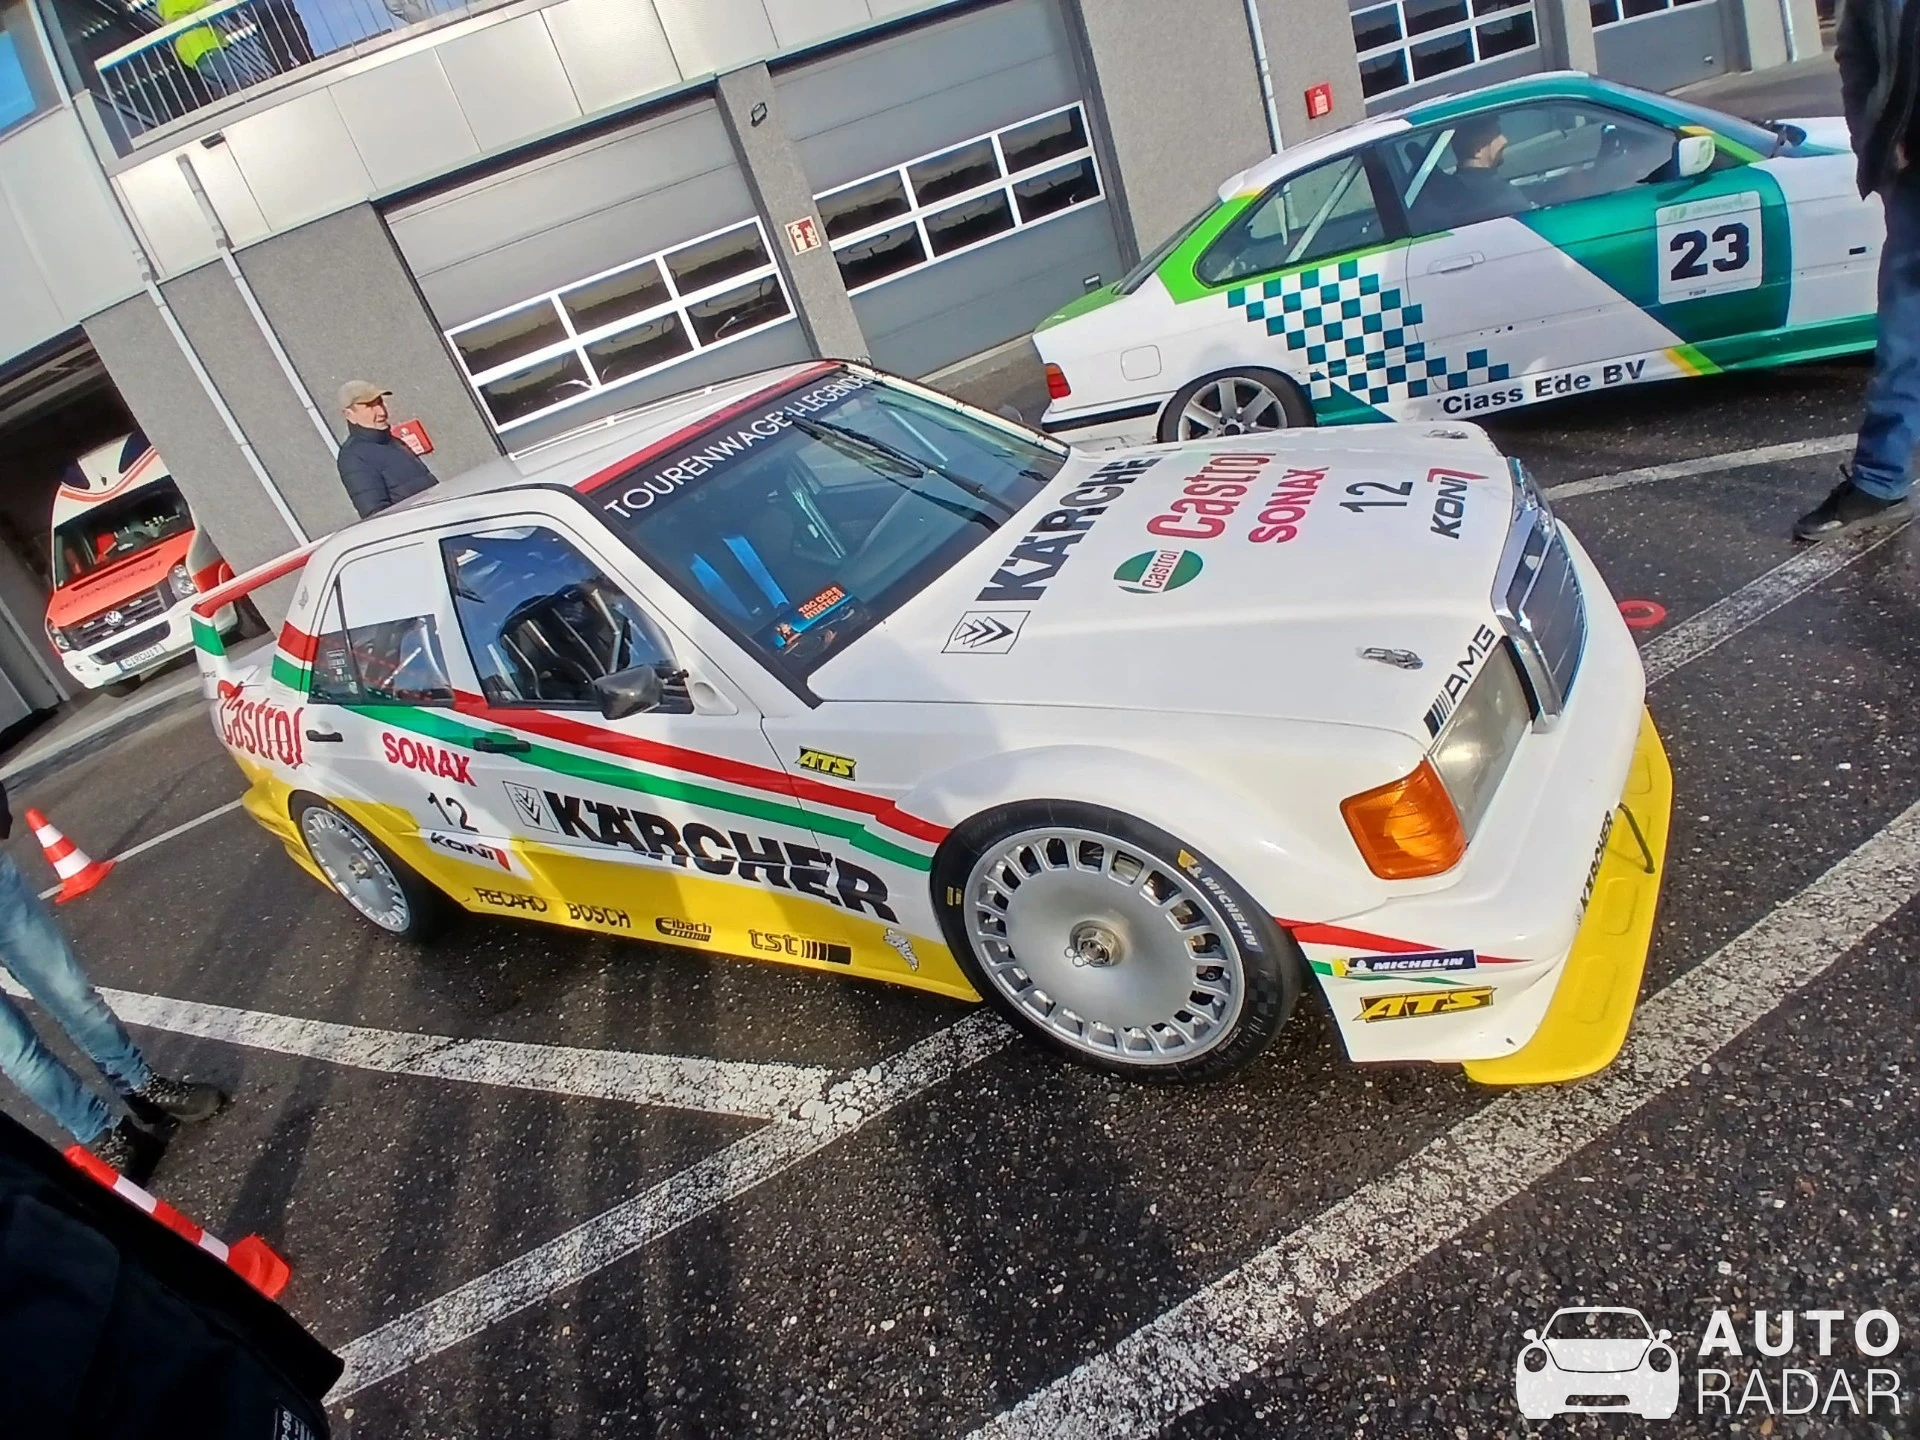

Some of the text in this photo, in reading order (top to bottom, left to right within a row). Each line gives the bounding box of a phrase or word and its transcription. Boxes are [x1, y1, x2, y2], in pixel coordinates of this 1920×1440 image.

[1669, 222, 1750, 281] 23
[1535, 372, 1592, 398] Ede
[1602, 359, 1646, 385] BV
[1146, 452, 1277, 539] Castrol
[1247, 466, 1330, 543] SONAX
[1338, 481, 1414, 513] 12
[1430, 476, 1468, 539] KONI
[1141, 549, 1181, 589] Castrol
[123, 647, 161, 667] CIRCUIT
[1443, 624, 1496, 706] AMG
[217, 679, 304, 770] Castrol
[382, 732, 477, 787] SONAX
[797, 750, 856, 776] ATS
[427, 792, 480, 833] 12
[430, 831, 495, 860] KONI
[542, 790, 901, 924] KÄRCHER
[472, 886, 549, 913] RECARO
[564, 901, 632, 928] BOSCH
[1200, 876, 1258, 946] MICHELIN
[654, 916, 713, 938] Eibach
[747, 928, 799, 956] tst
[1372, 957, 1465, 971] MICHELIN
[1352, 985, 1498, 1022] ATS
